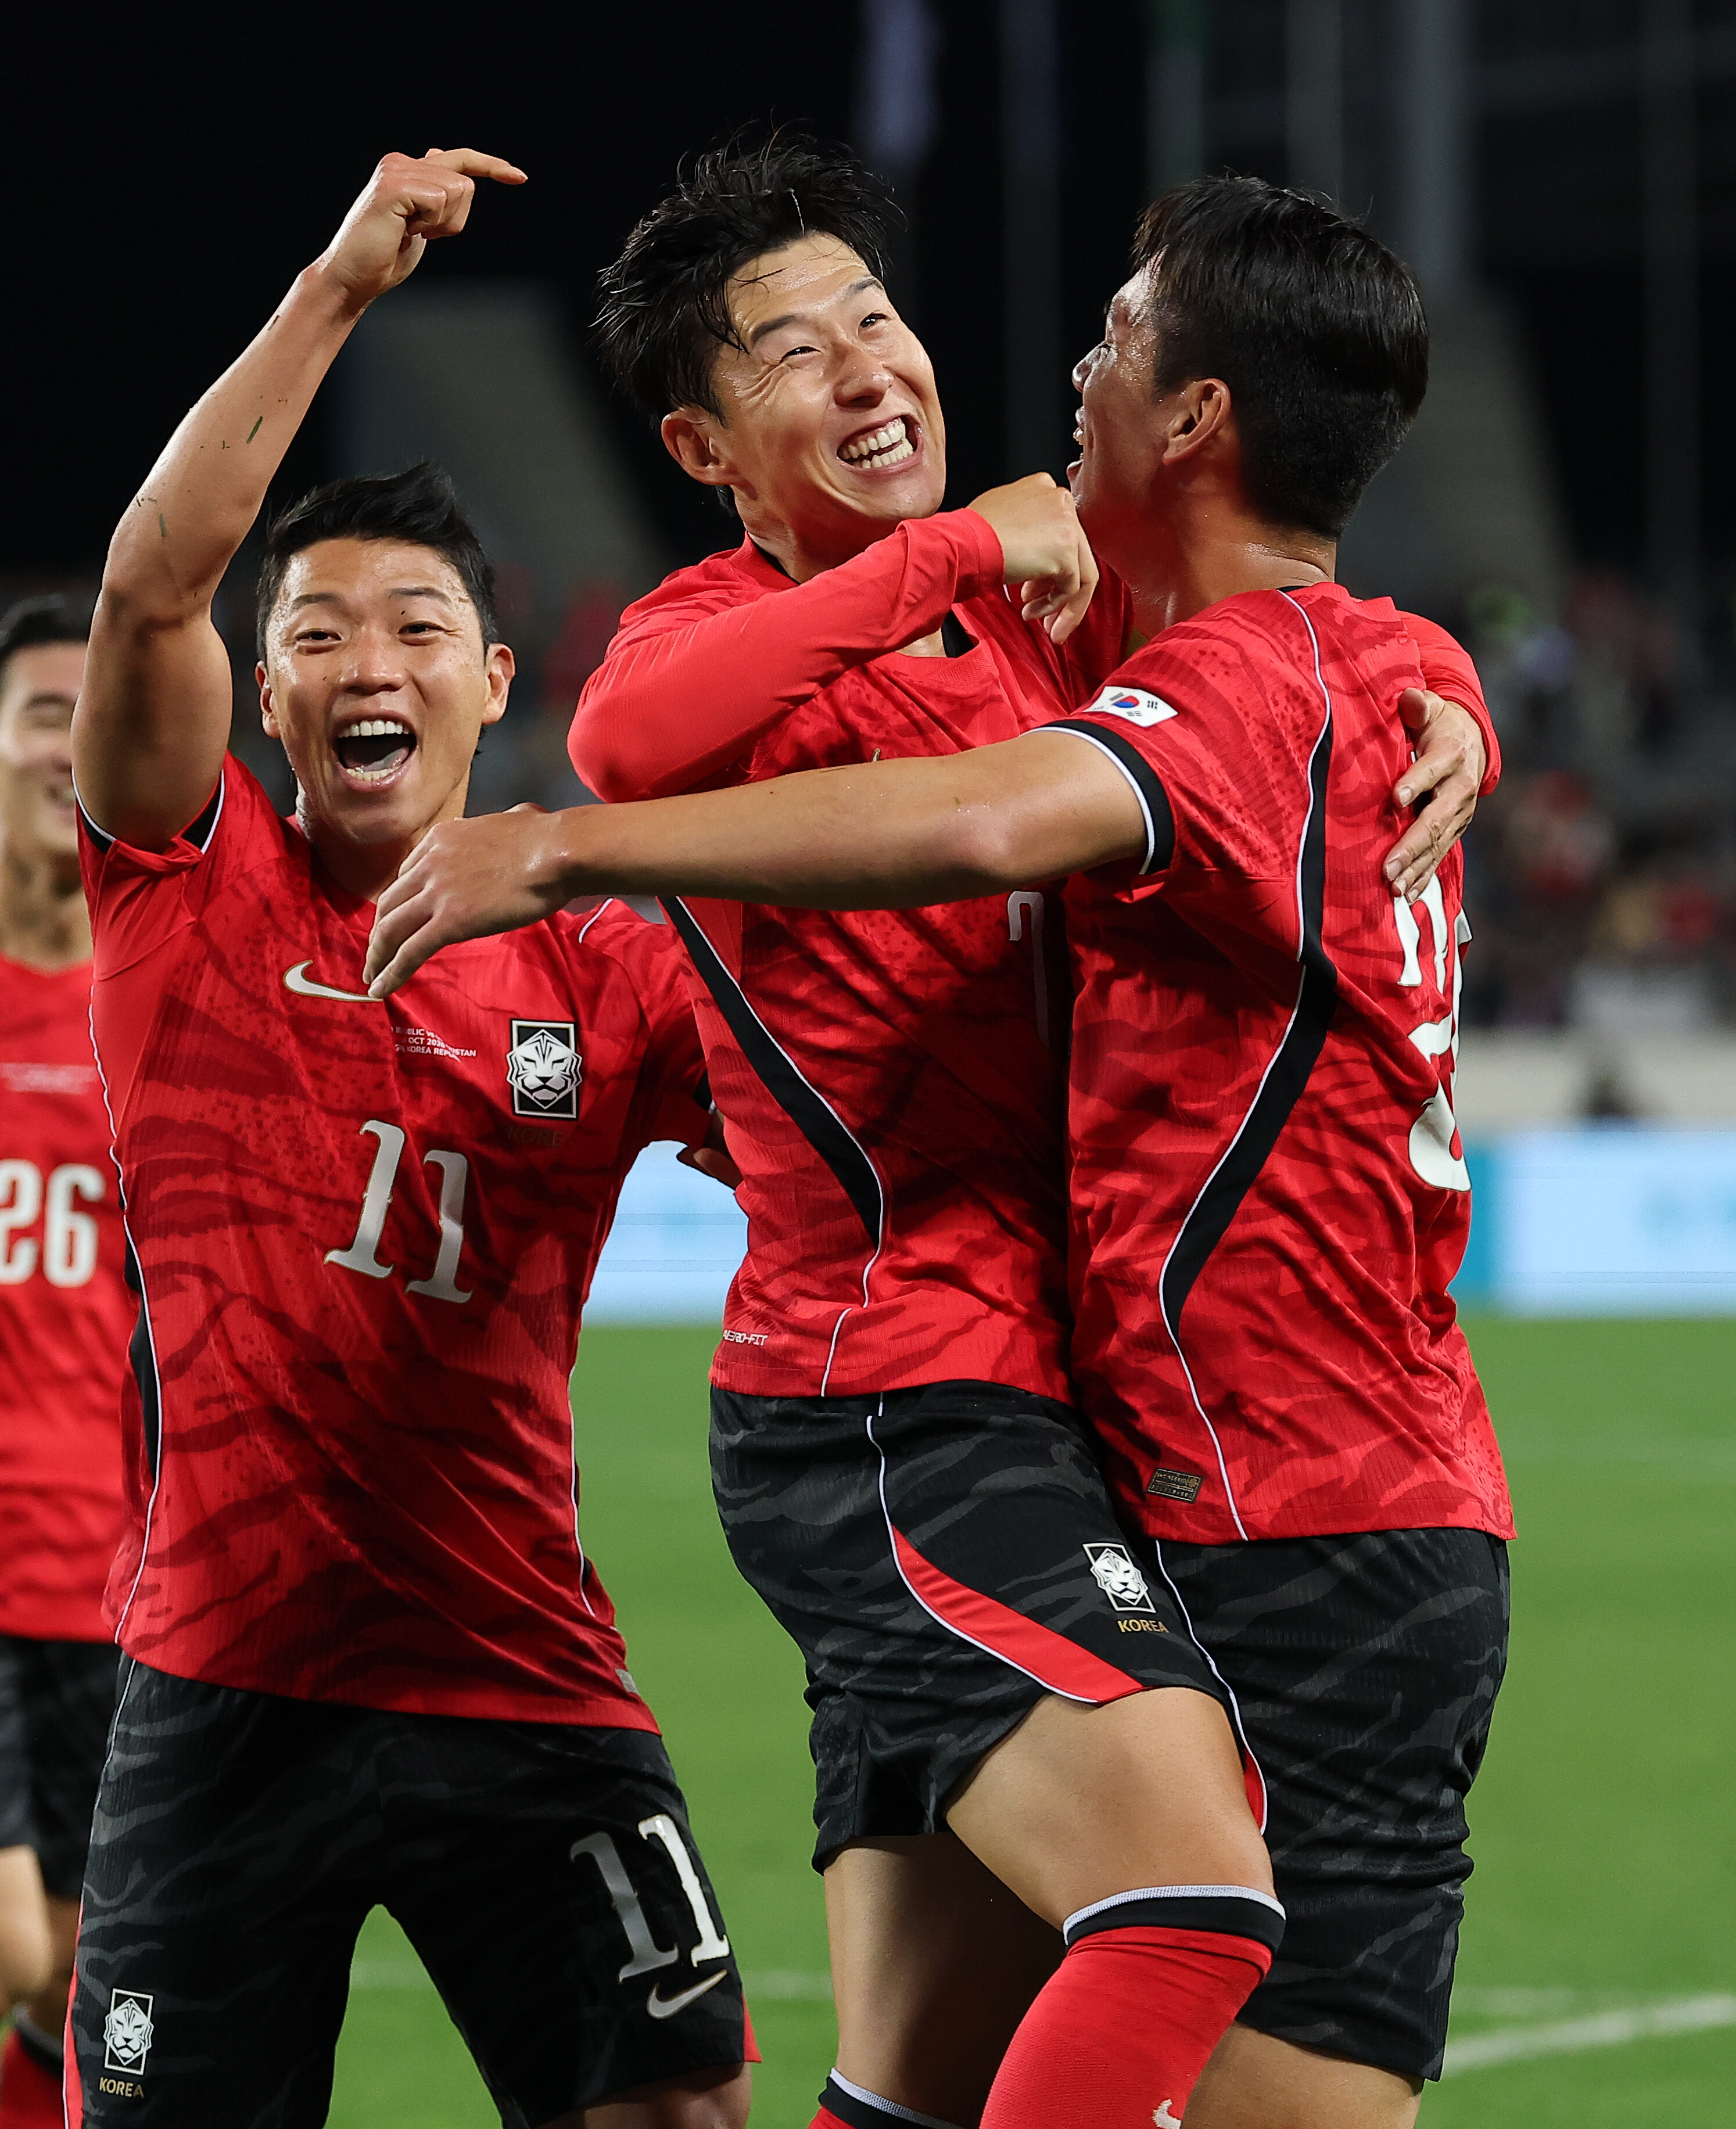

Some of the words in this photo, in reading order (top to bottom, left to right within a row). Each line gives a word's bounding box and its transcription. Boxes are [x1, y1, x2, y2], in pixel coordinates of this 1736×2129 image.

[408, 1037, 425, 1045] OCT
[0, 1159, 106, 1287] 26
[324, 1119, 474, 1303] 11
[1117, 1619, 1170, 1633] KOREA
[571, 1814, 730, 1984] 11
[99, 2076, 144, 2098] KOREA
